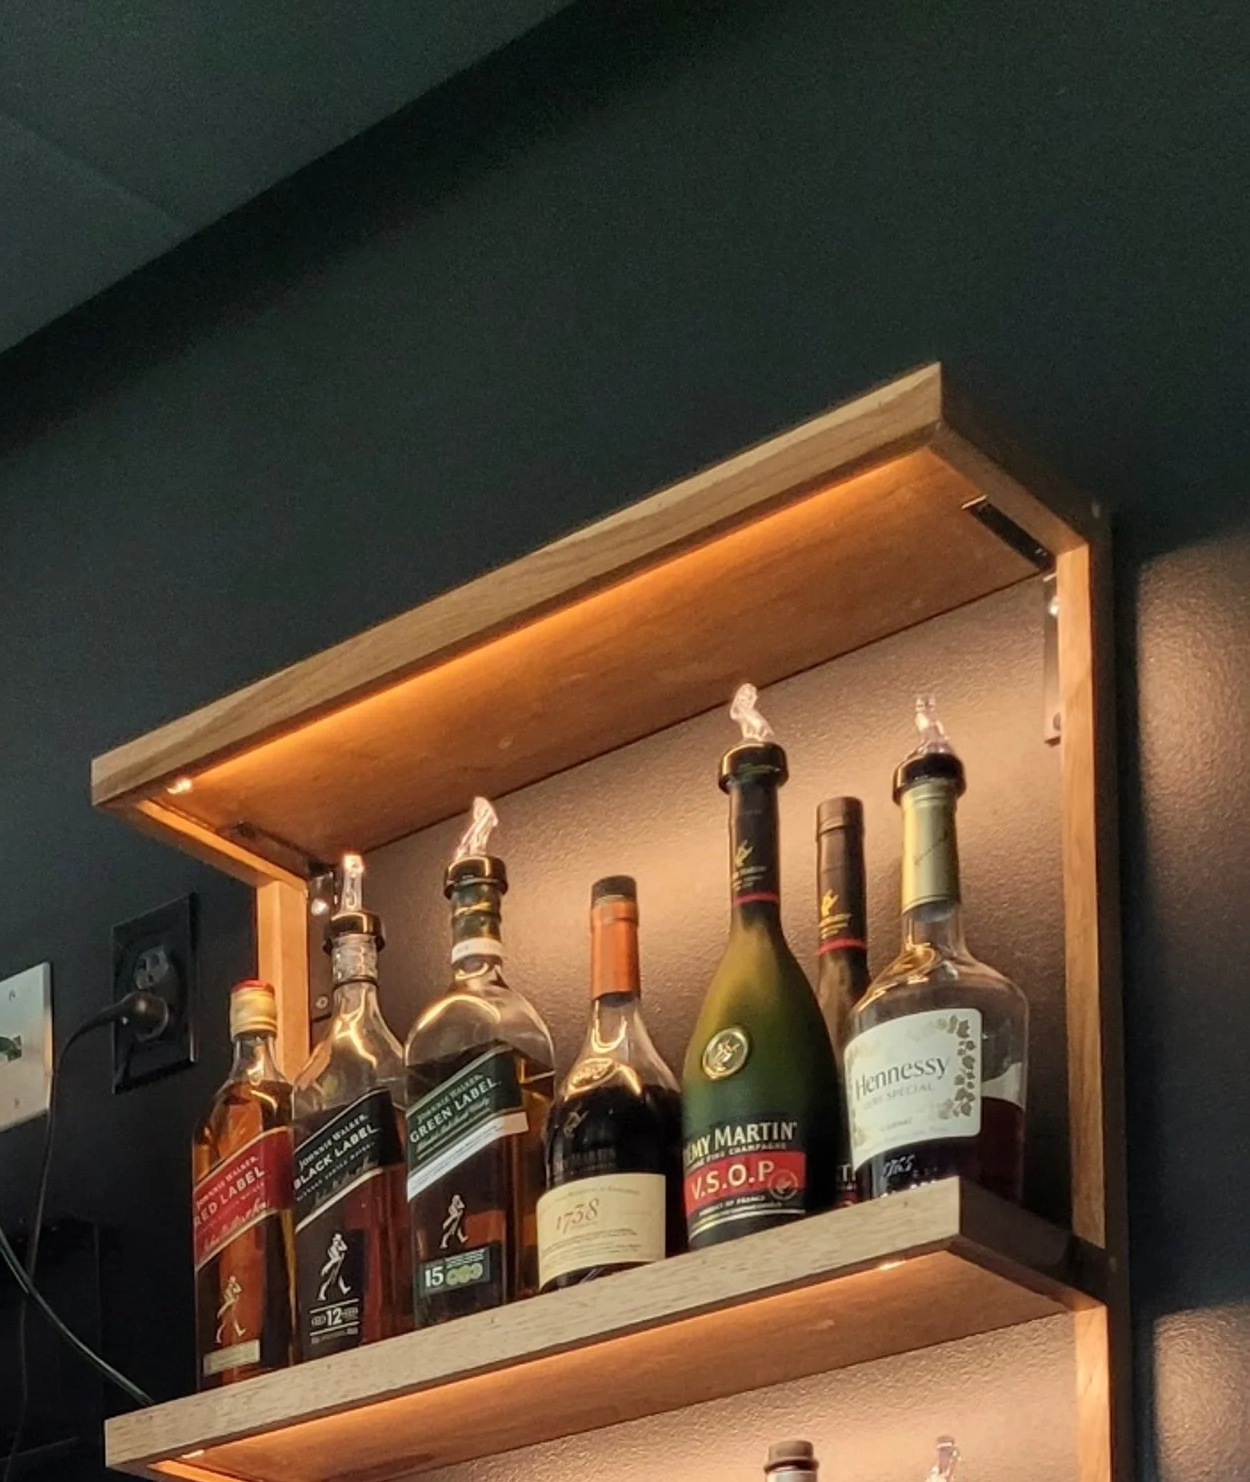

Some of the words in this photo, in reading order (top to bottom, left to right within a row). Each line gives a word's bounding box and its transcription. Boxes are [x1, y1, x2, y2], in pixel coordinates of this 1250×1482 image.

[854, 1057, 948, 1100] Hennessy
[886, 1083, 936, 1102] SPECIAL
[409, 1108, 452, 1144] GREEN
[454, 1077, 496, 1113] LABEL
[293, 1154, 333, 1190] BLACK
[335, 1123, 378, 1157] LABEL
[299, 1139, 332, 1171] JOHNNIE
[332, 1114, 369, 1142] WALKER
[714, 1122, 794, 1150] MARTIN
[193, 1202, 218, 1227] RED
[221, 1166, 266, 1204] LABEL
[691, 1160, 775, 1200] V.S.O.P
[425, 1266, 445, 1287] 15
[326, 1307, 343, 1327] 12
